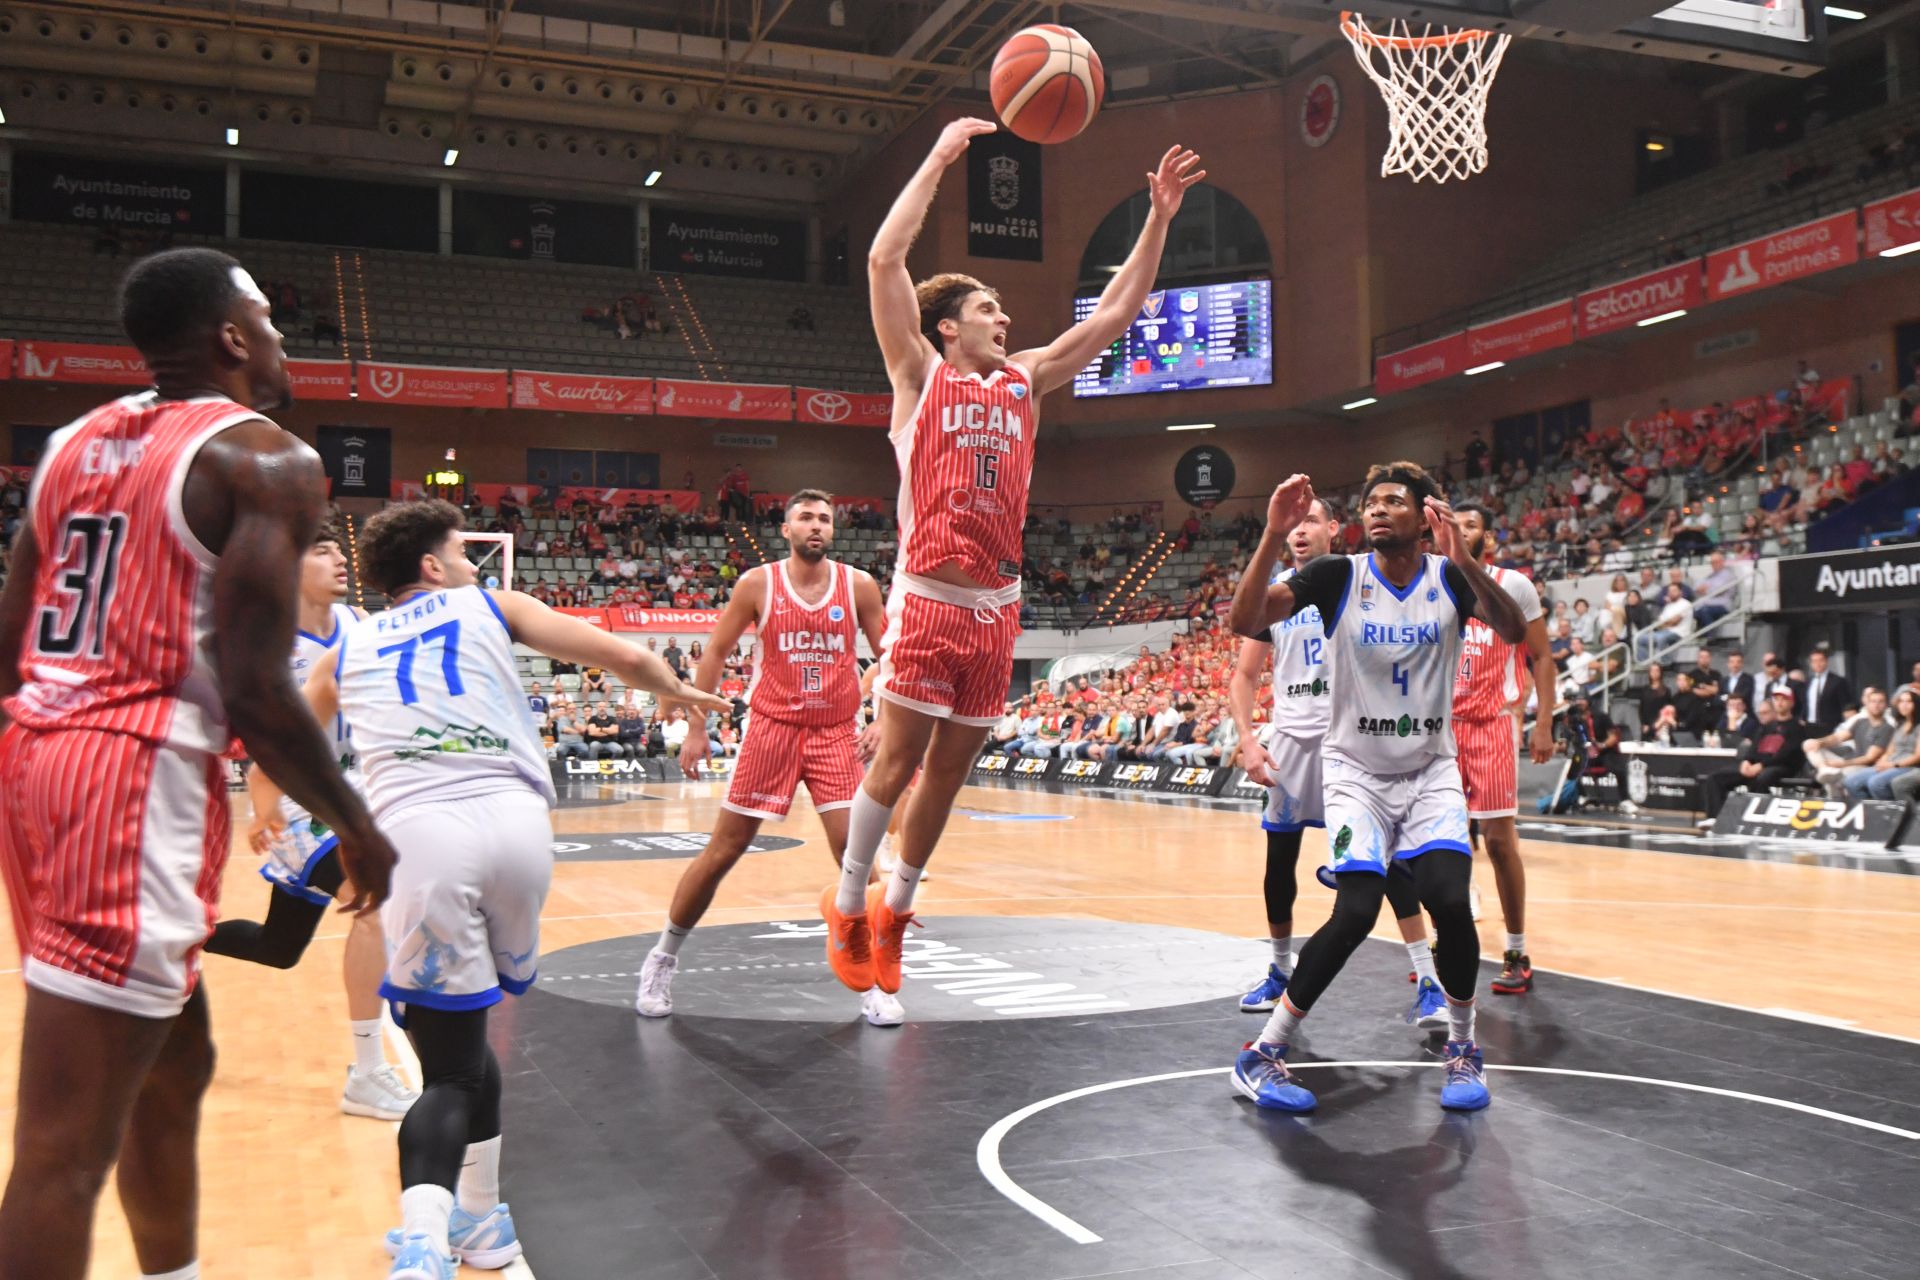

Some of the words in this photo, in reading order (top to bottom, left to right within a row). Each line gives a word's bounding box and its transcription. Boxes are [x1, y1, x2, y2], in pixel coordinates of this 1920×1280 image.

[53, 174, 192, 201] Ayuntamiento
[72, 203, 97, 218] de
[103, 205, 172, 225] Murcia
[667, 222, 779, 247] Ayuntamiento
[970, 221, 1038, 239] MURCIA
[1766, 226, 1830, 257] Asterra
[708, 249, 764, 268] Murcia
[1766, 246, 1840, 280] Partners
[1586, 275, 1689, 322] setcomur
[1143, 326, 1159, 340] 19
[1185, 322, 1194, 337] 9
[1158, 342, 1182, 355] 0.0
[63, 356, 123, 370] IBERIA
[942, 403, 1023, 441] UCAM
[956, 434, 1011, 455] MURCIA
[974, 452, 1000, 491] 16
[37, 512, 129, 659] 31
[377, 592, 450, 632] PETROV
[779, 630, 845, 653] UCAM
[1362, 620, 1441, 646] RILSKI
[1464, 624, 1493, 647] AM
[377, 619, 465, 706] 77
[789, 652, 834, 664] MURCIA
[1303, 637, 1323, 666] 12
[1464, 645, 1482, 656] CIA
[802, 666, 822, 692] 15
[1391, 662, 1409, 697] 4
[1424, 717, 1443, 734] 90
[566, 759, 645, 775] LIBERA
[1742, 797, 1866, 831] LIBERA
[1736, 825, 1860, 842] TELECOM
